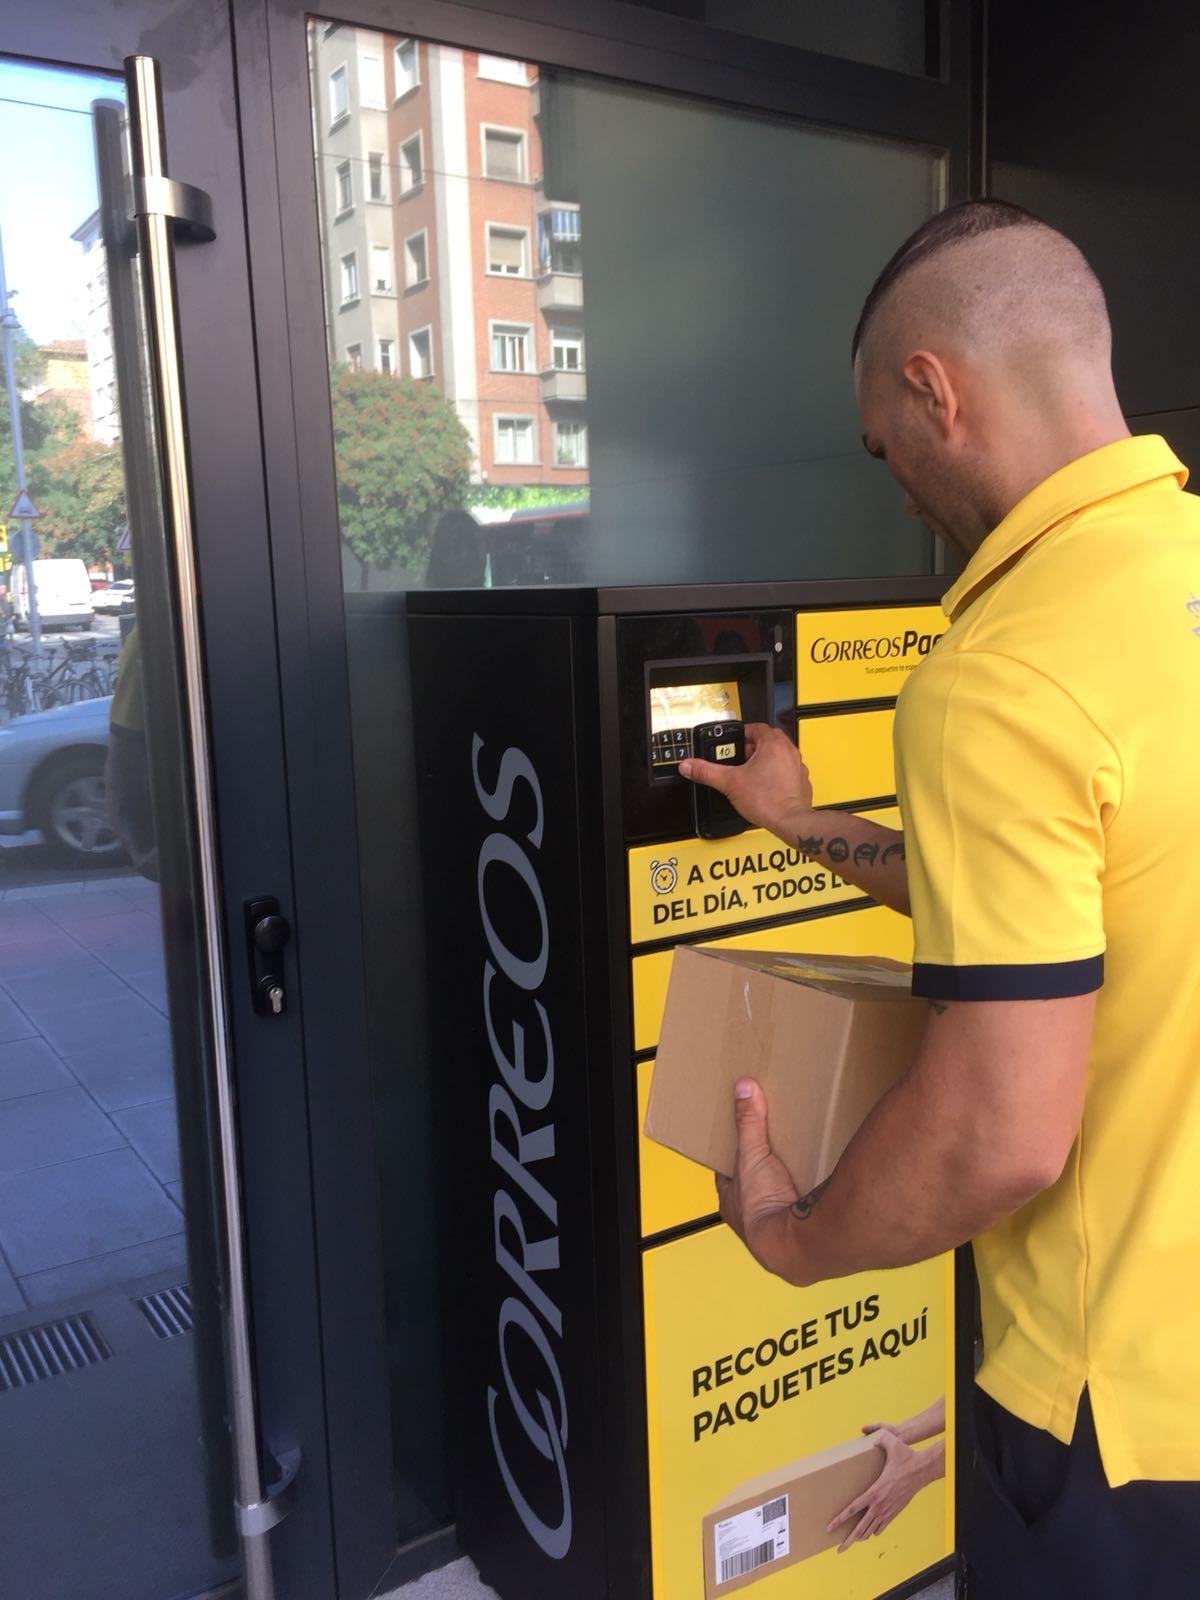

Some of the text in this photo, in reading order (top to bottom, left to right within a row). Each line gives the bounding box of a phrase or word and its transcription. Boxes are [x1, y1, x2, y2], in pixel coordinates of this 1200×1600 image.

[663, 734, 668, 742] 1
[676, 732, 682, 741] 2
[664, 749, 671, 759] 6
[678, 748, 684, 757] 7
[686, 848, 815, 886] A CUALQUI
[653, 898, 698, 925] DEL
[703, 886, 748, 915] DÍA,
[752, 872, 826, 904] TODOS
[471, 730, 573, 1560] CORREOS
[691, 1294, 880, 1398] RECOGE TUS
[693, 1307, 929, 1443] PAQUETES AQUÍ
